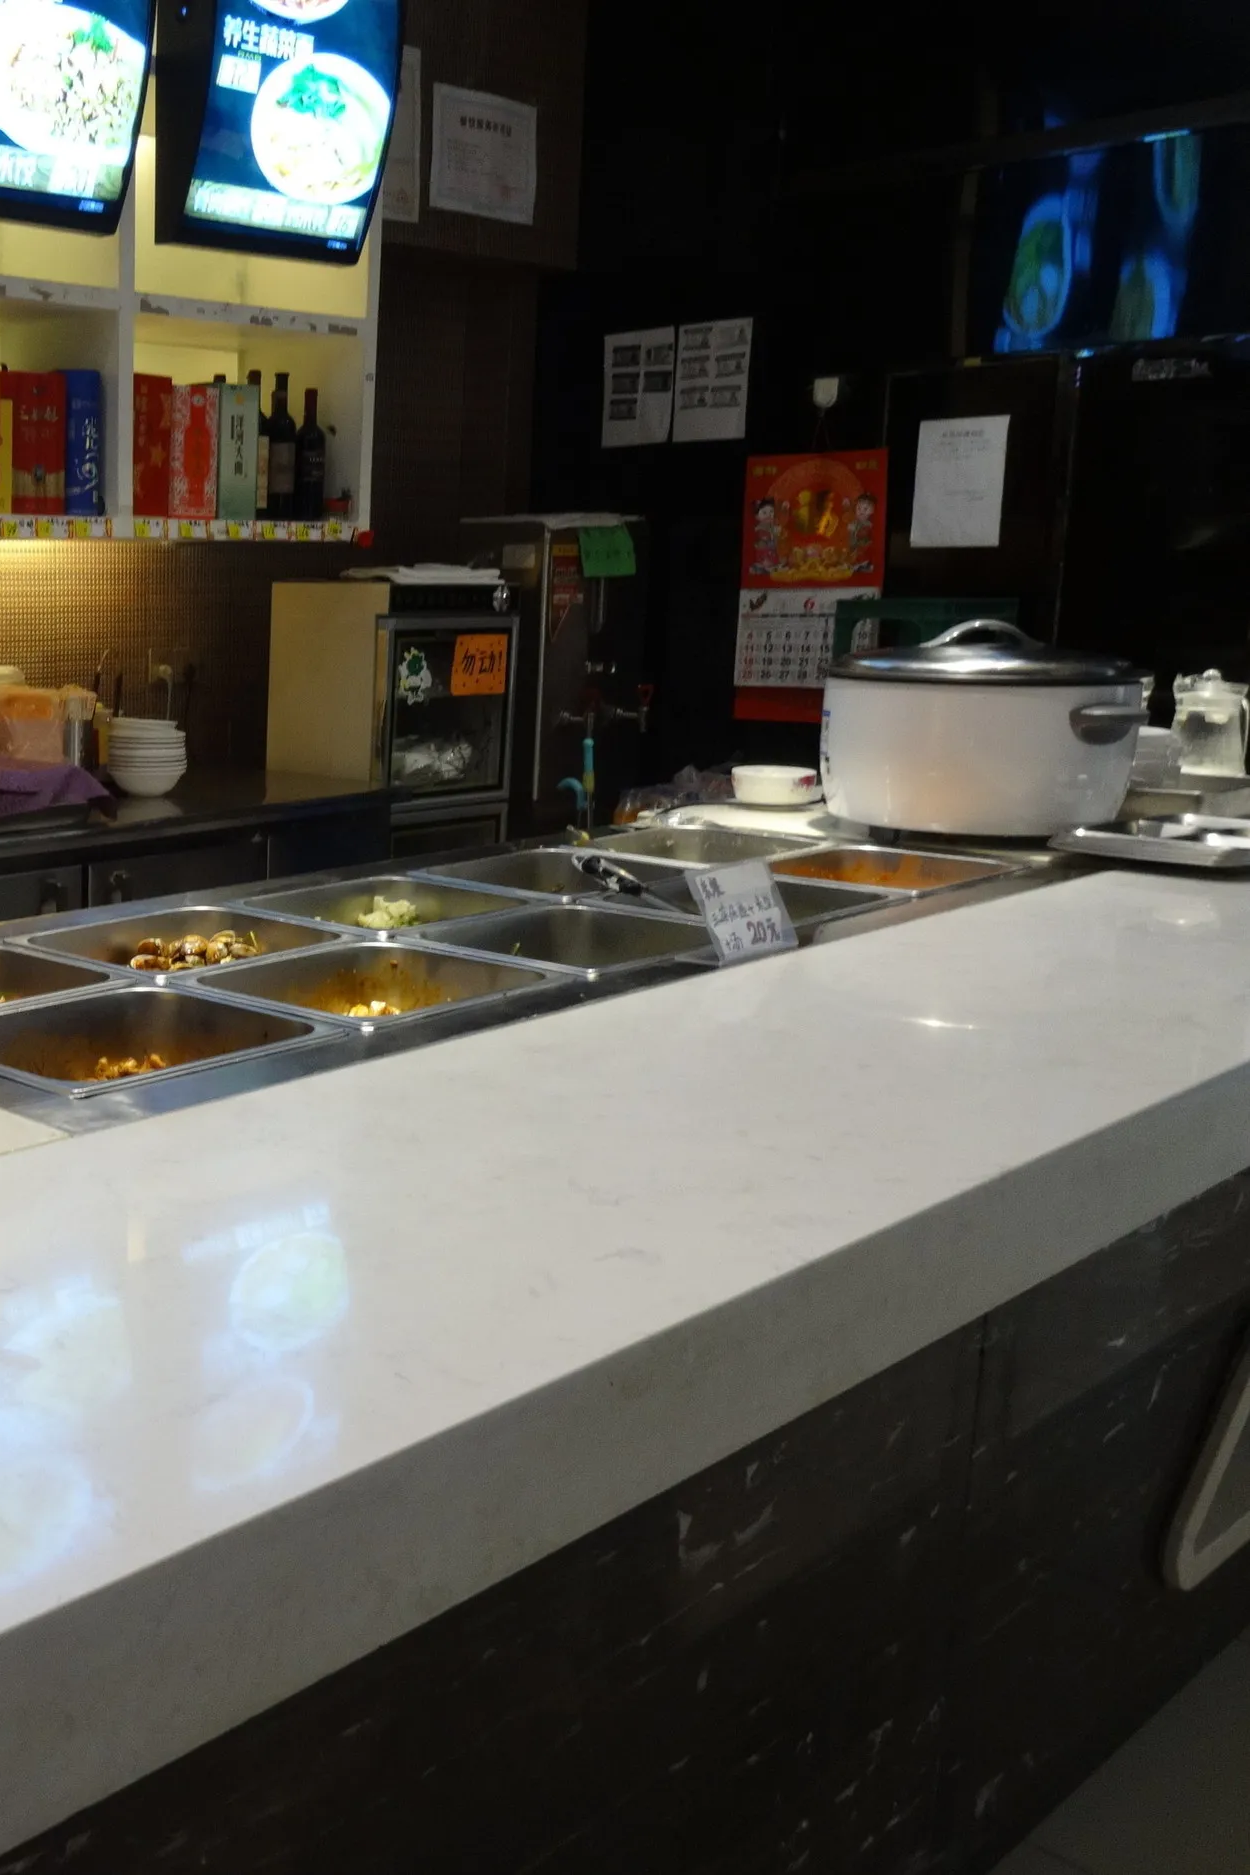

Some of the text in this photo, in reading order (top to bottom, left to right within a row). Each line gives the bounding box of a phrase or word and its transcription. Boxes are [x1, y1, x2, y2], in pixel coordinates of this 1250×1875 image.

[234, 413, 246, 477] 洋河大曲
[461, 647, 503, 676] 勿动!
